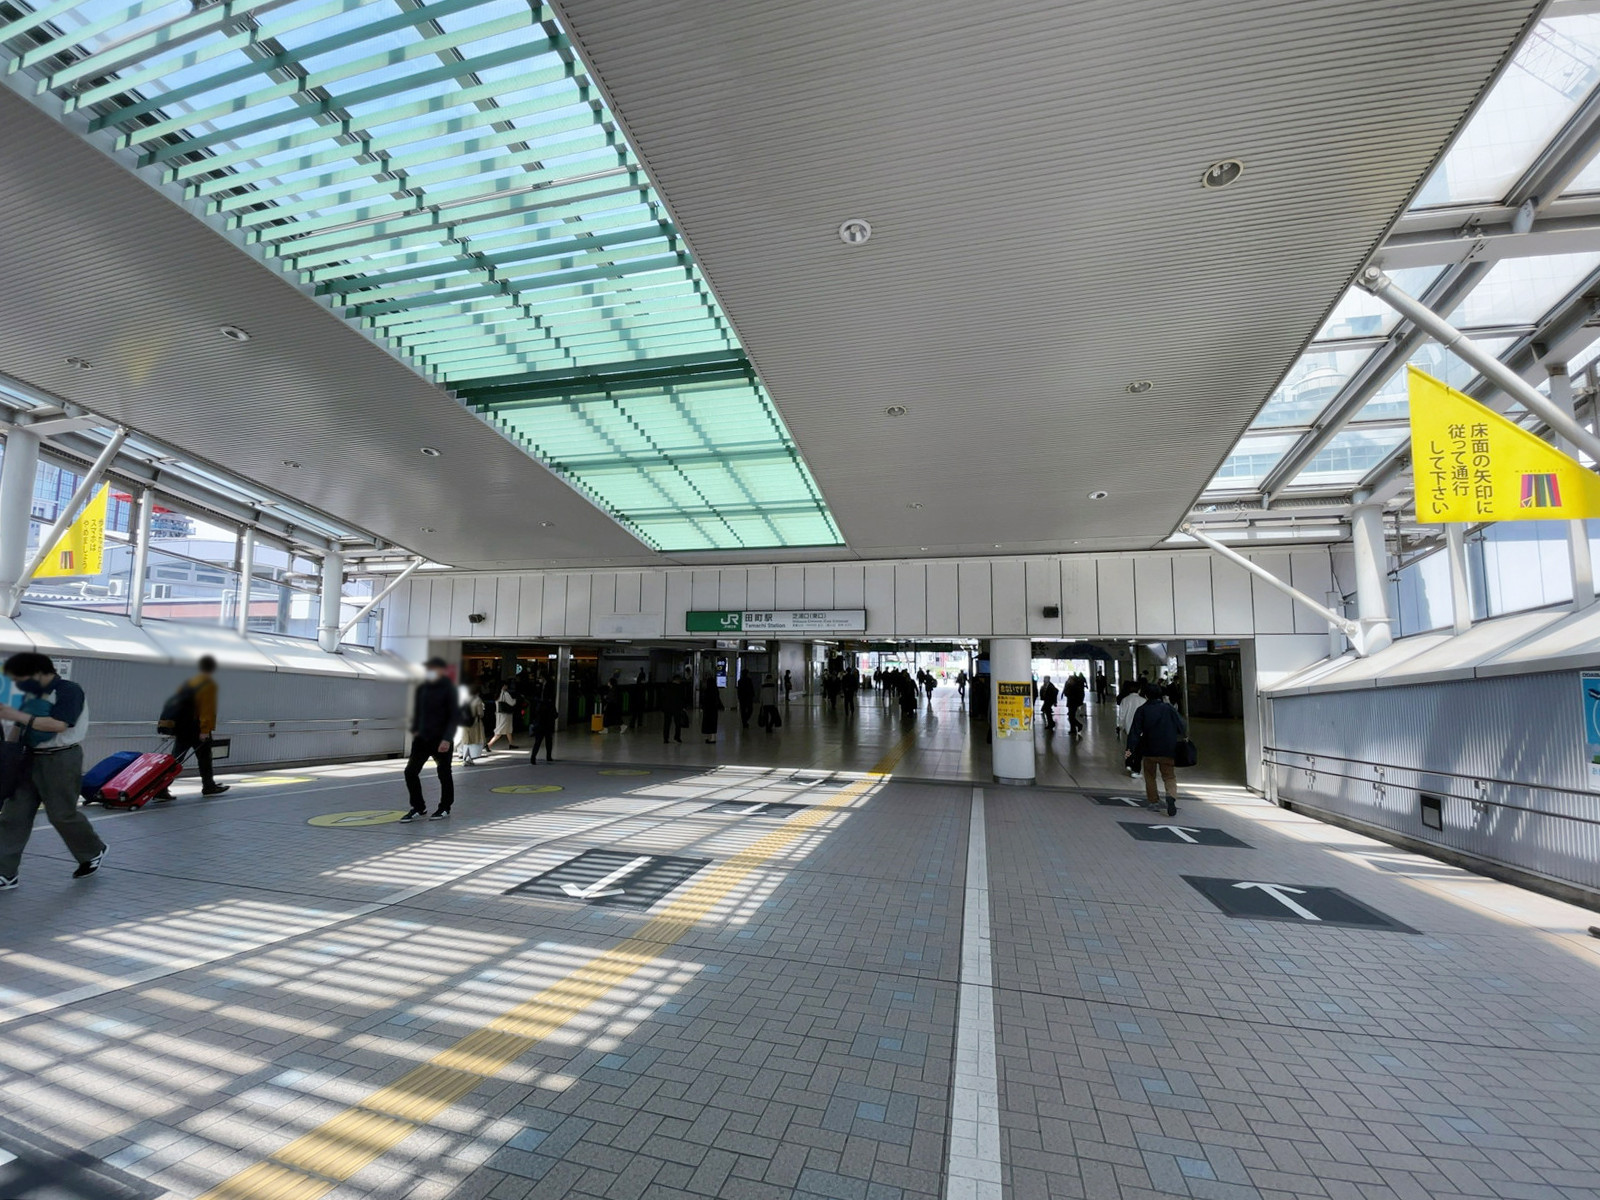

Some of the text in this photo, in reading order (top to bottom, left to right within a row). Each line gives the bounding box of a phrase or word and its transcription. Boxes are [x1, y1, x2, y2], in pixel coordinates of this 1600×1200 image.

[1429, 441, 1449, 514] して下さい
[1448, 424, 1469, 496] 従って通行
[1471, 423, 1493, 514] 床面の矢印に
[720, 614, 739, 625] JR
[745, 614, 773, 622] 田町駅
